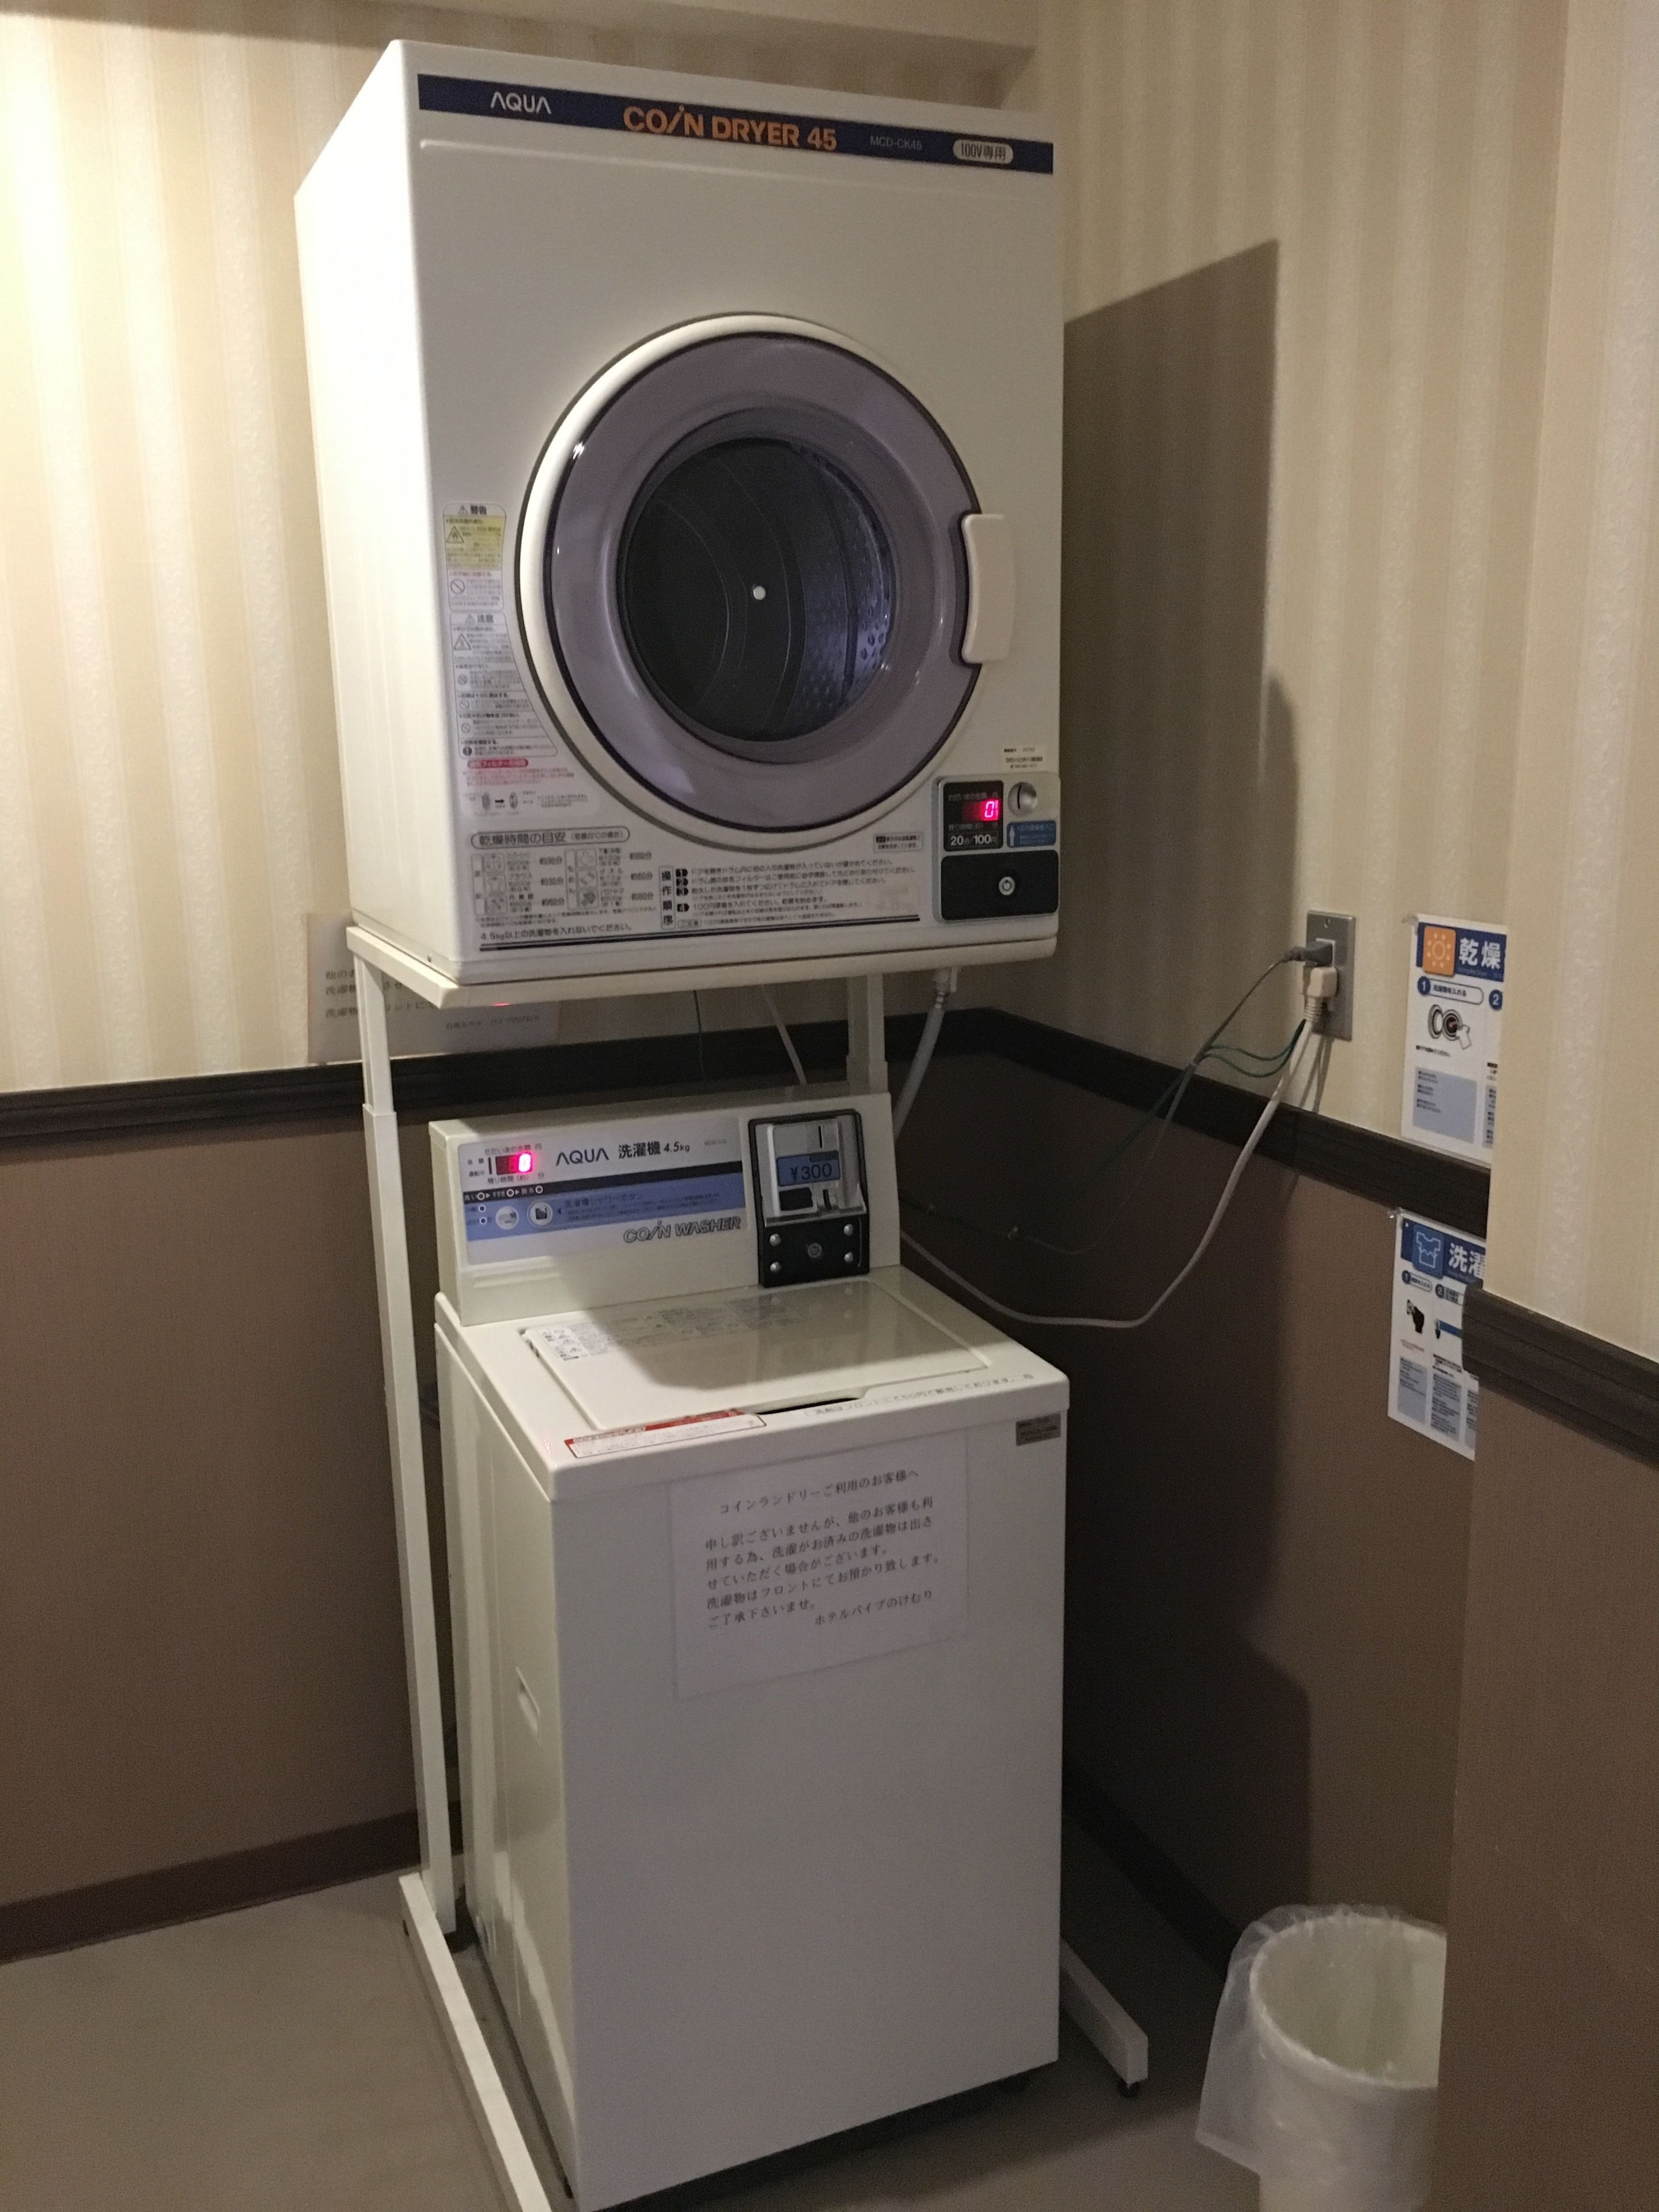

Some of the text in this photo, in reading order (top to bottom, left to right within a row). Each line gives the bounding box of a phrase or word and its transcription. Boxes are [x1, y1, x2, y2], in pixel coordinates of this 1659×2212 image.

[490, 90, 552, 115] AQUA
[712, 117, 800, 147] DRYER
[808, 127, 837, 150] 45
[480, 832, 566, 846] 乾燥時間の目安
[1459, 938, 1501, 969] 乾燥
[556, 1141, 690, 1166] AQUA 洗濯機 4.5kg
[675, 1216, 741, 1237] WASHER
[1448, 1242, 1485, 1280] 洗濯
[720, 1469, 919, 1514] コインランドリーご利用のお客様へ
[707, 1544, 888, 1589] せていただく場合がございます。
[707, 1554, 938, 1609] 洗濯物はフロントにてお預かり致します。
[815, 1590, 932, 1626] ホテルパイプのけむり
